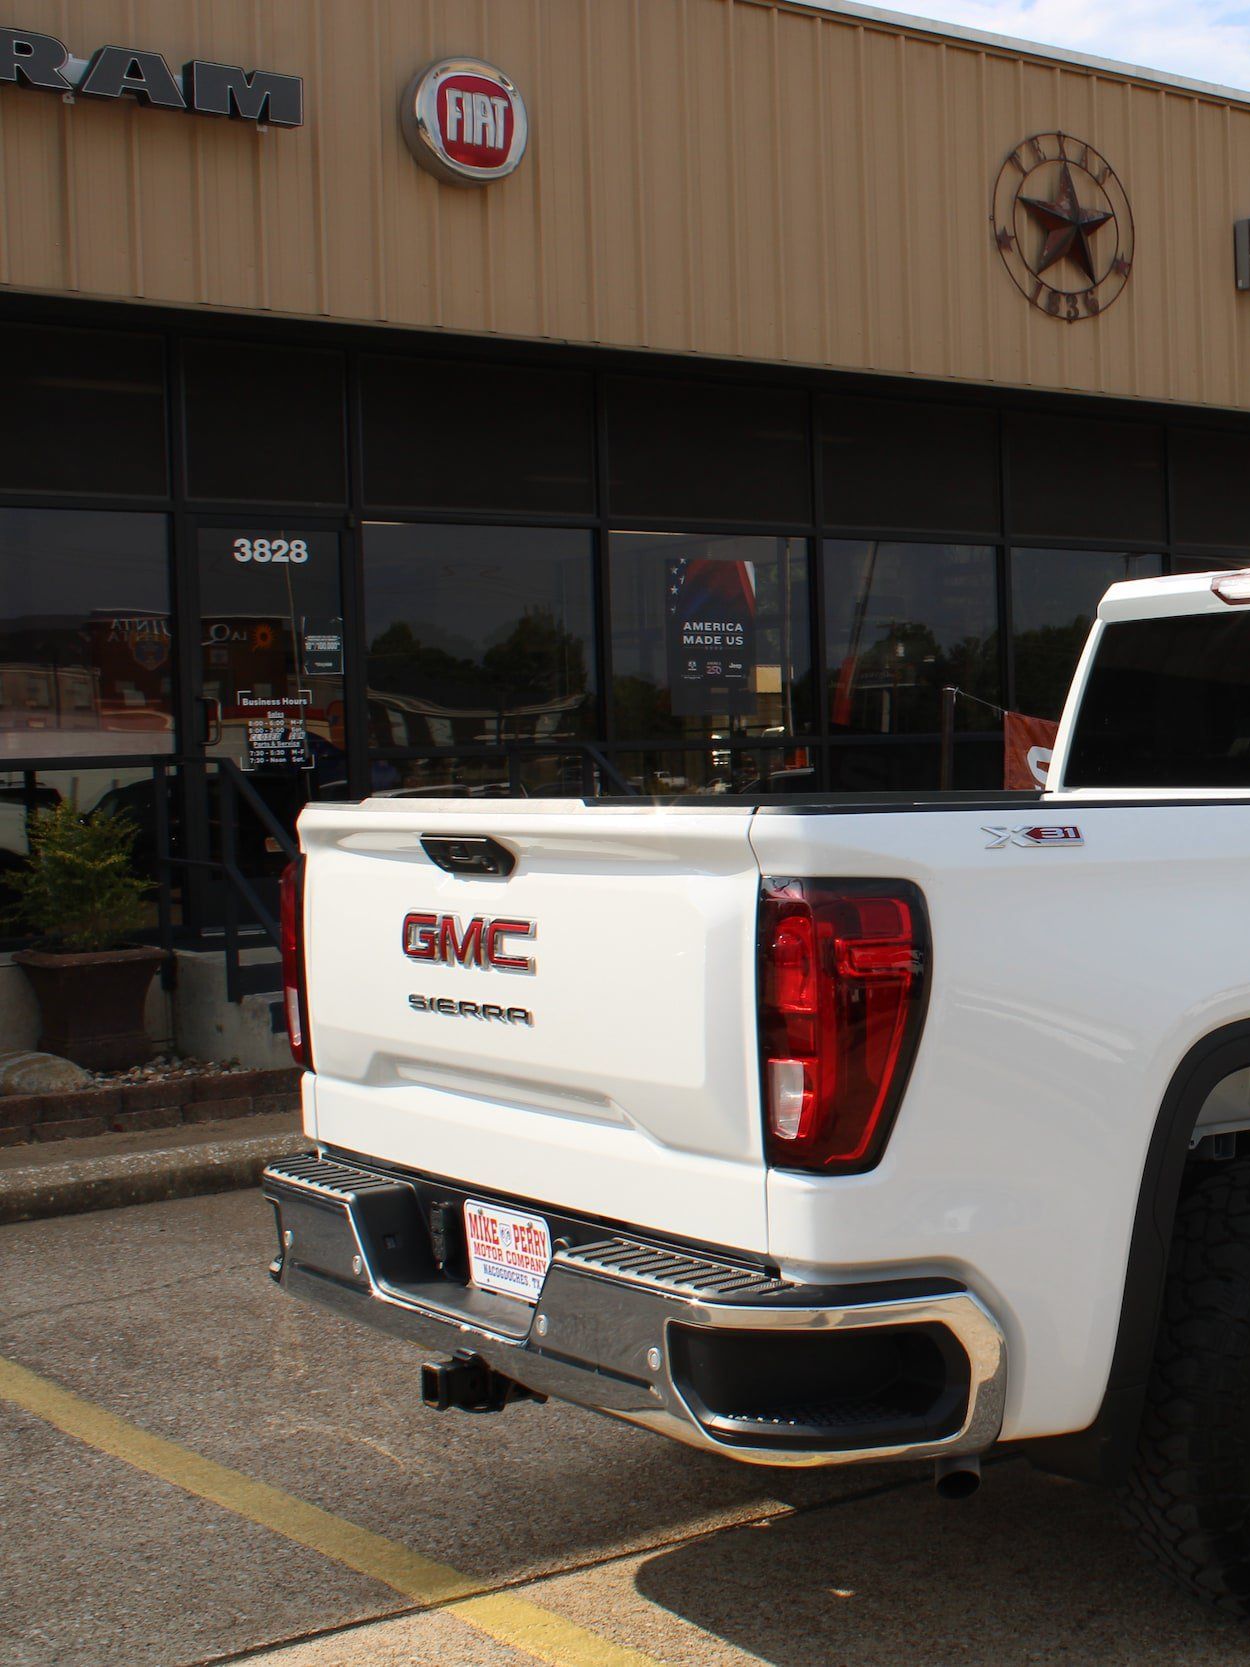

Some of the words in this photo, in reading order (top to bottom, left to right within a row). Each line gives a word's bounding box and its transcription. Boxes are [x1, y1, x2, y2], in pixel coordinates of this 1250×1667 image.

[0, 27, 303, 128] RAM
[445, 88, 509, 149] FIAT
[1030, 281, 1099, 320] 1836
[234, 538, 308, 563] 3828
[683, 621, 744, 632] AMERICA
[683, 635, 722, 645] MADE
[726, 636, 744, 646] US
[242, 697, 281, 706] Business
[282, 697, 308, 706] Hours
[979, 825, 1085, 850] X31
[402, 911, 537, 975] GMC
[408, 994, 534, 1027] SIERRA
[468, 1212, 500, 1246] MIKE
[512, 1223, 547, 1258] PERRY
[473, 1241, 504, 1262] MOTOR
[506, 1250, 547, 1274] COMPANY
